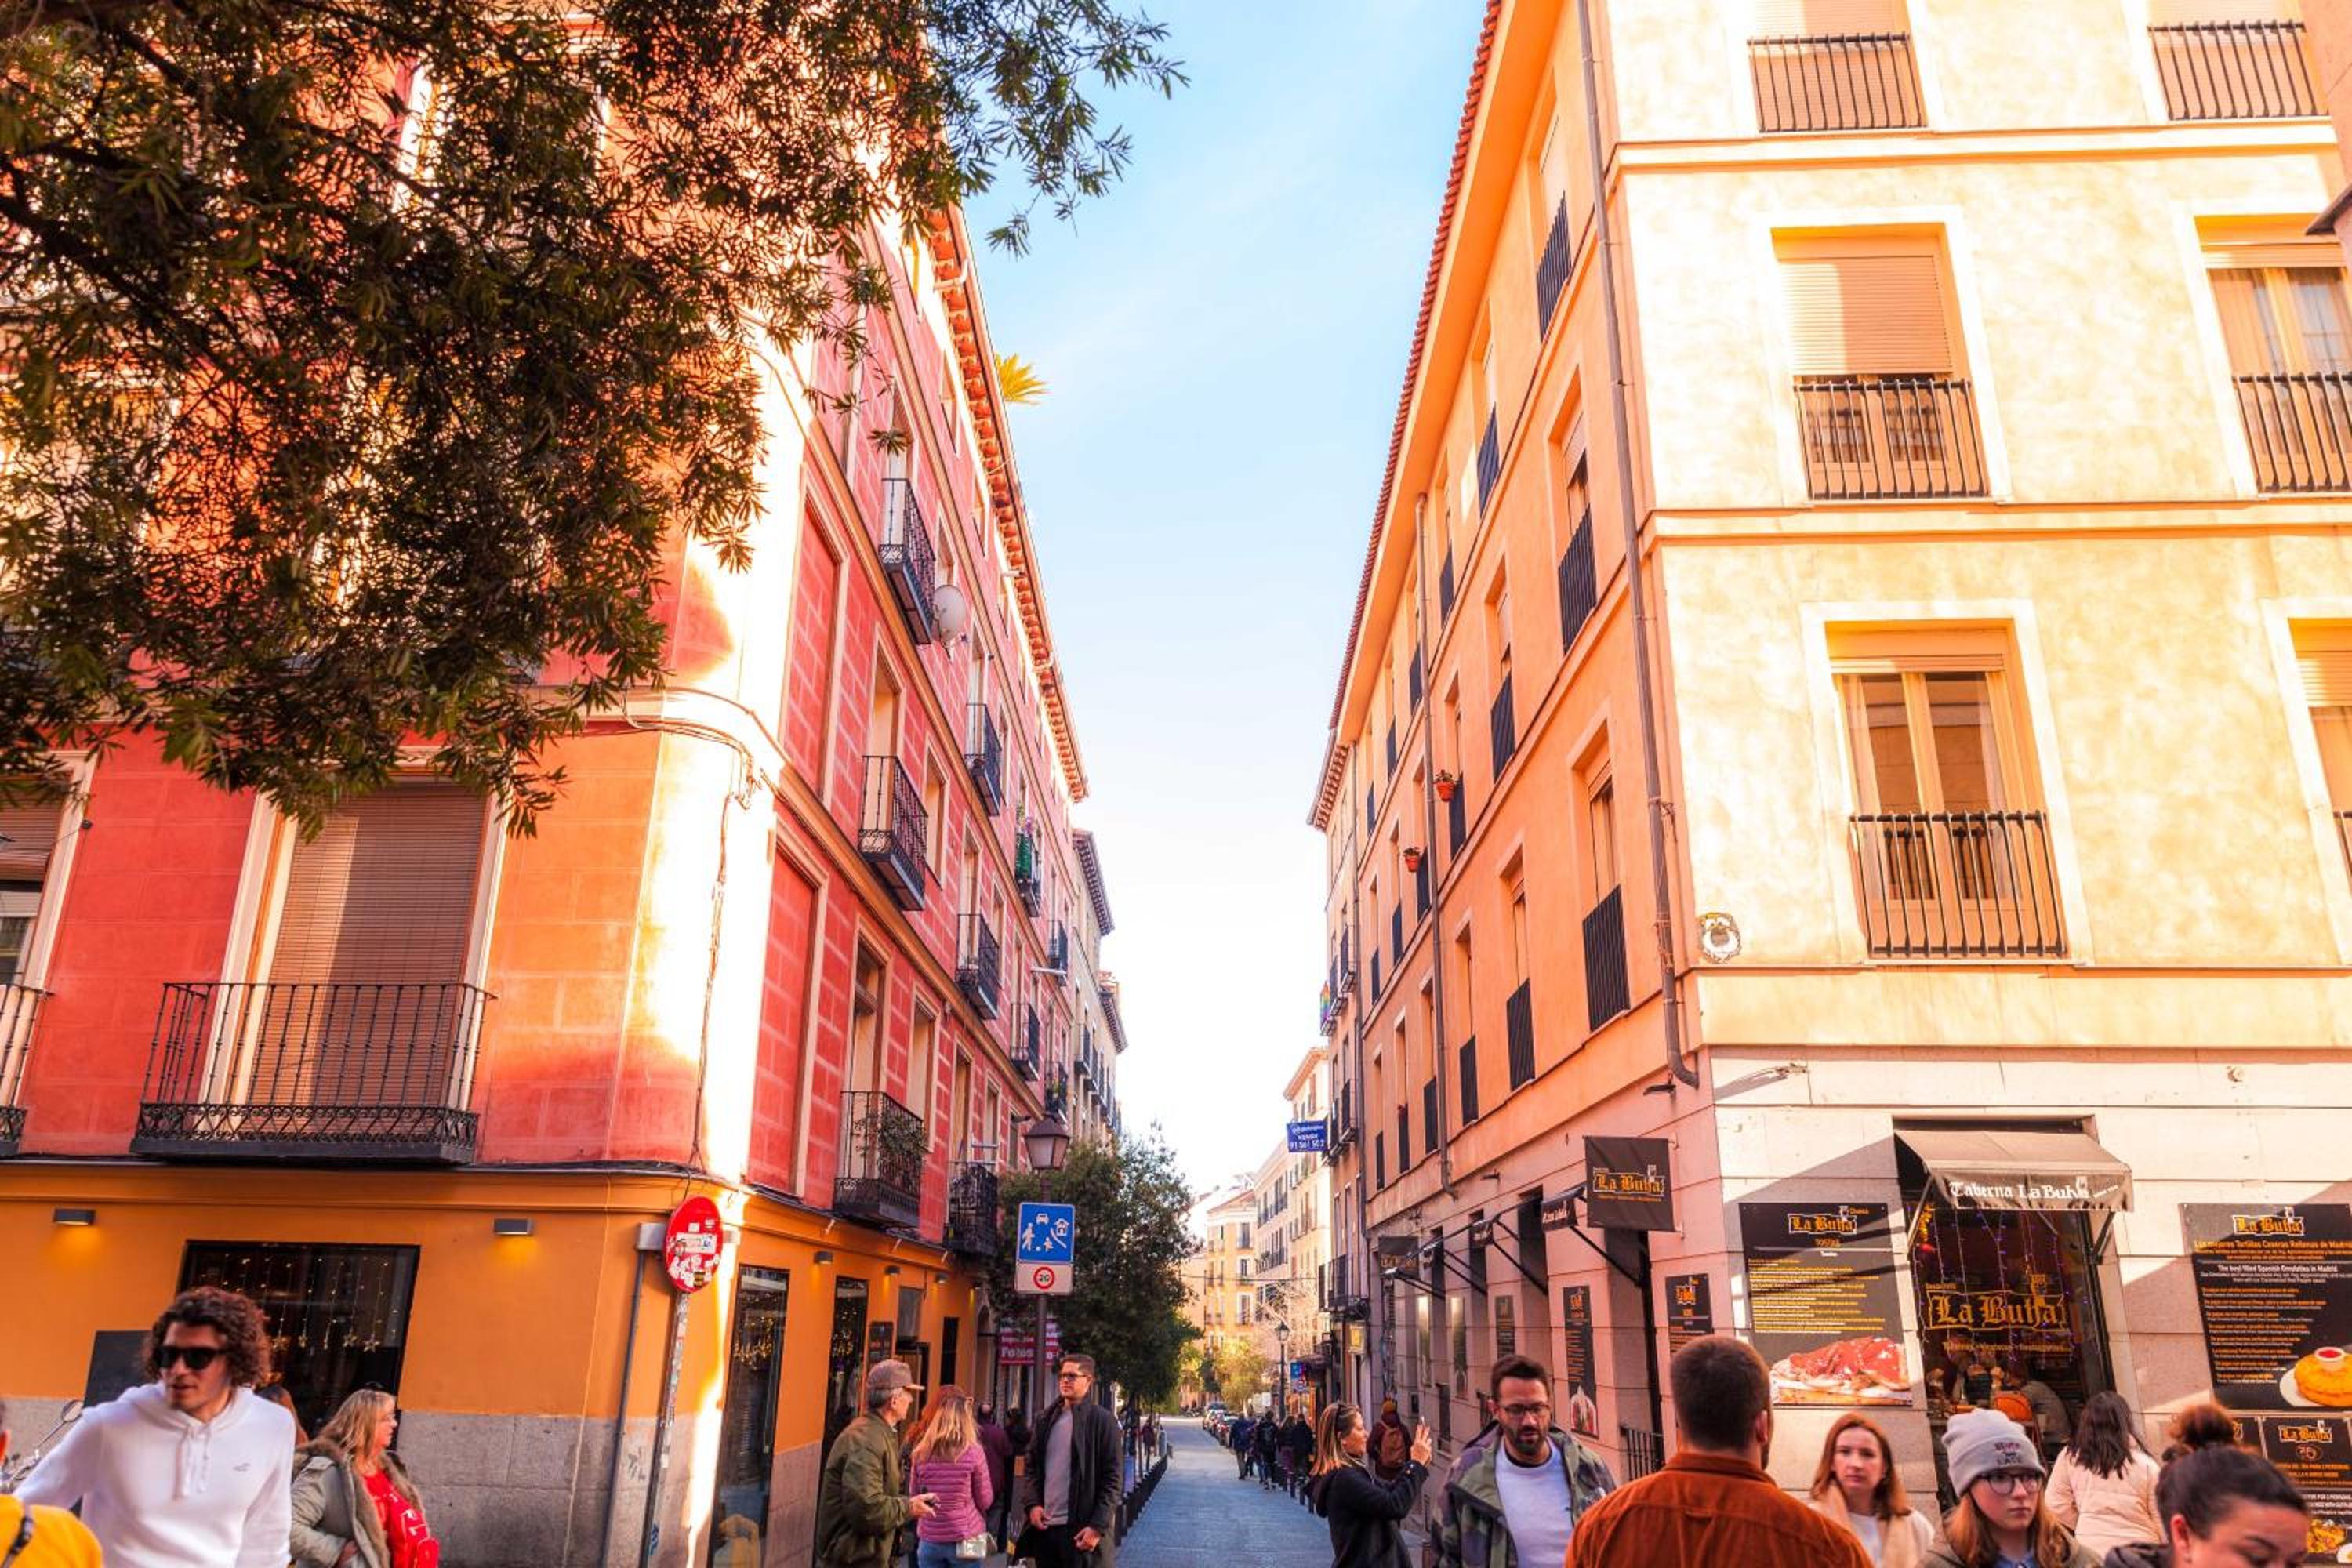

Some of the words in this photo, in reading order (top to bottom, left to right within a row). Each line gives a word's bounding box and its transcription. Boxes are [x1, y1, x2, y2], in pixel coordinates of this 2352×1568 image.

[1950, 1181, 2014, 1198] Taberna
[1791, 1216, 1811, 1230] La
[2238, 1218, 2258, 1232] La
[1932, 1295, 1973, 1324] La
